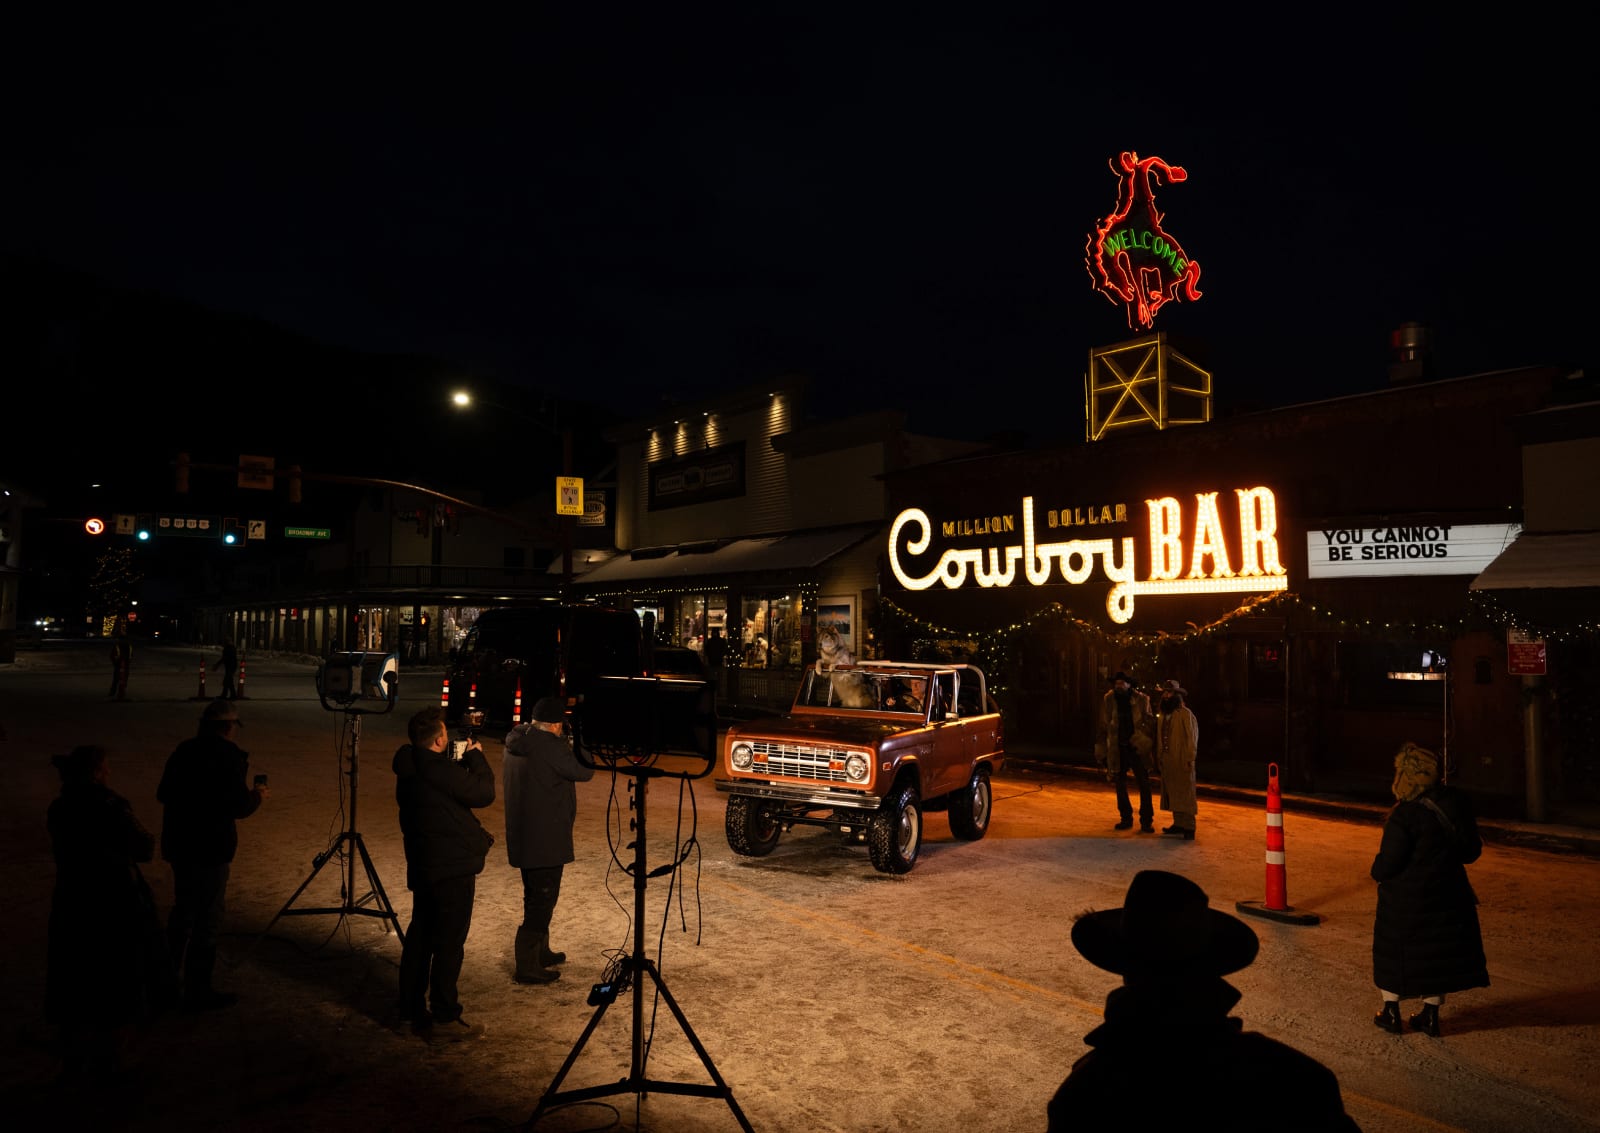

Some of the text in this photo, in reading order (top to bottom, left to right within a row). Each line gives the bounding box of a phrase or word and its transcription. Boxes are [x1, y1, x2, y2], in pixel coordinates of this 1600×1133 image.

[1102, 228, 1188, 277] WELCOME
[942, 503, 1128, 537] MILLION DOLLAR
[1322, 527, 1451, 545] YOU CANNOT
[888, 486, 1288, 624] Cowboy BAR
[1328, 543, 1448, 561] BE SERIOUS
